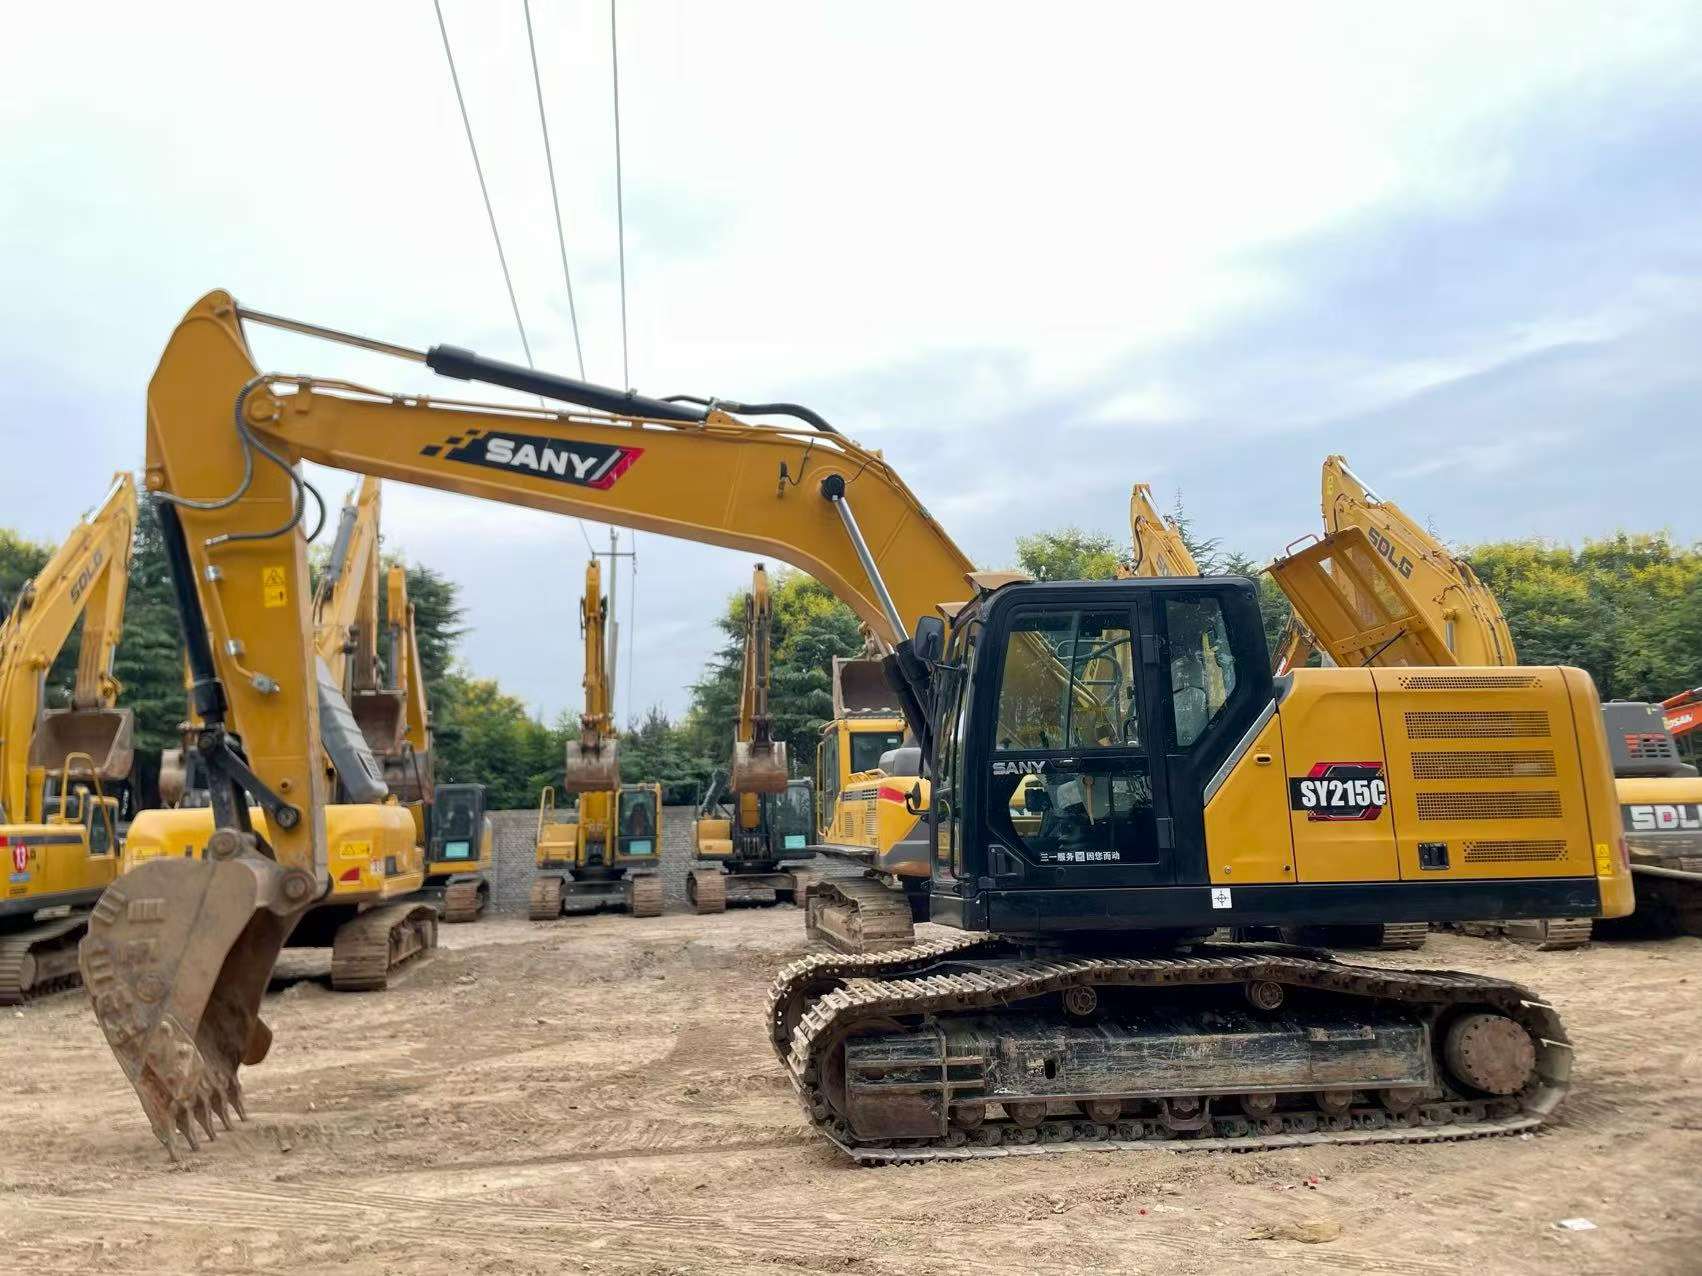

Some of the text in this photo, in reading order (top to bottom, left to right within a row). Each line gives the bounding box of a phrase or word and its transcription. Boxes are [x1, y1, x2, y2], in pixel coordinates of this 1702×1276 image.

[485, 437, 598, 479] SANY
[1368, 526, 1414, 580] SDLG
[992, 760, 1046, 776] SANY
[1300, 779, 1387, 808] SY215C
[1630, 804, 1702, 830] SDL
